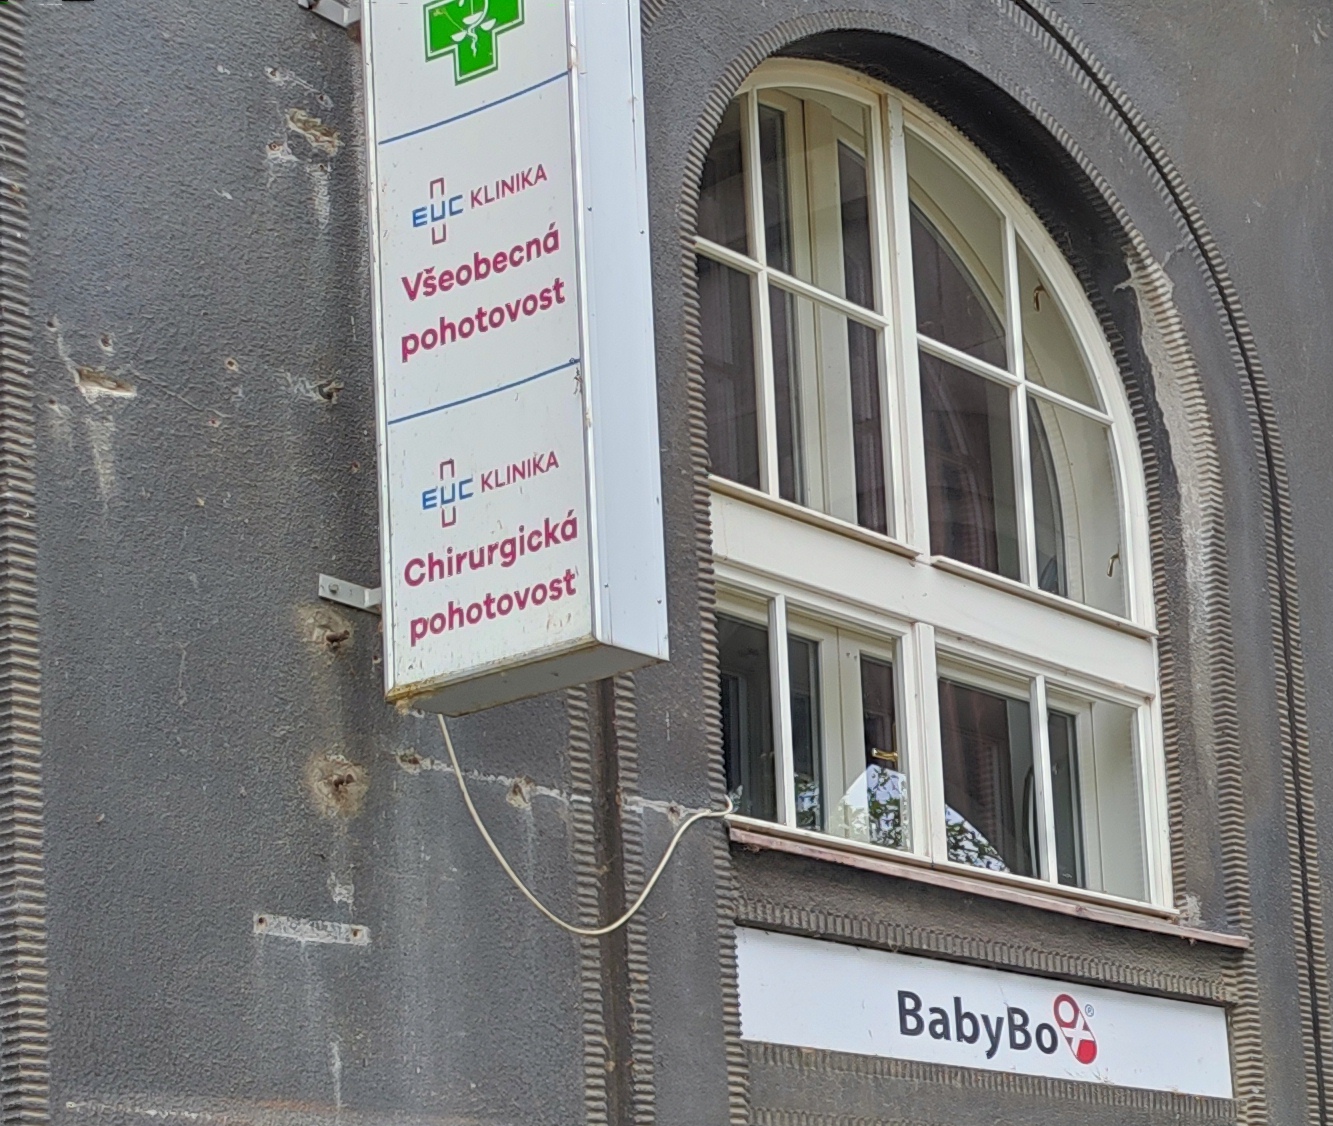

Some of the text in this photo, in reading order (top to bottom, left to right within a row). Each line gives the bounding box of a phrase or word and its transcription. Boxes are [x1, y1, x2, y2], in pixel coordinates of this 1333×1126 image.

[471, 163, 548, 209] KLINIKA
[401, 222, 559, 301] Všeobecná
[402, 278, 566, 363] pohotovost
[481, 451, 559, 493] KLINIKA
[404, 509, 578, 587] Chirurgická
[410, 569, 577, 647] pohotovost
